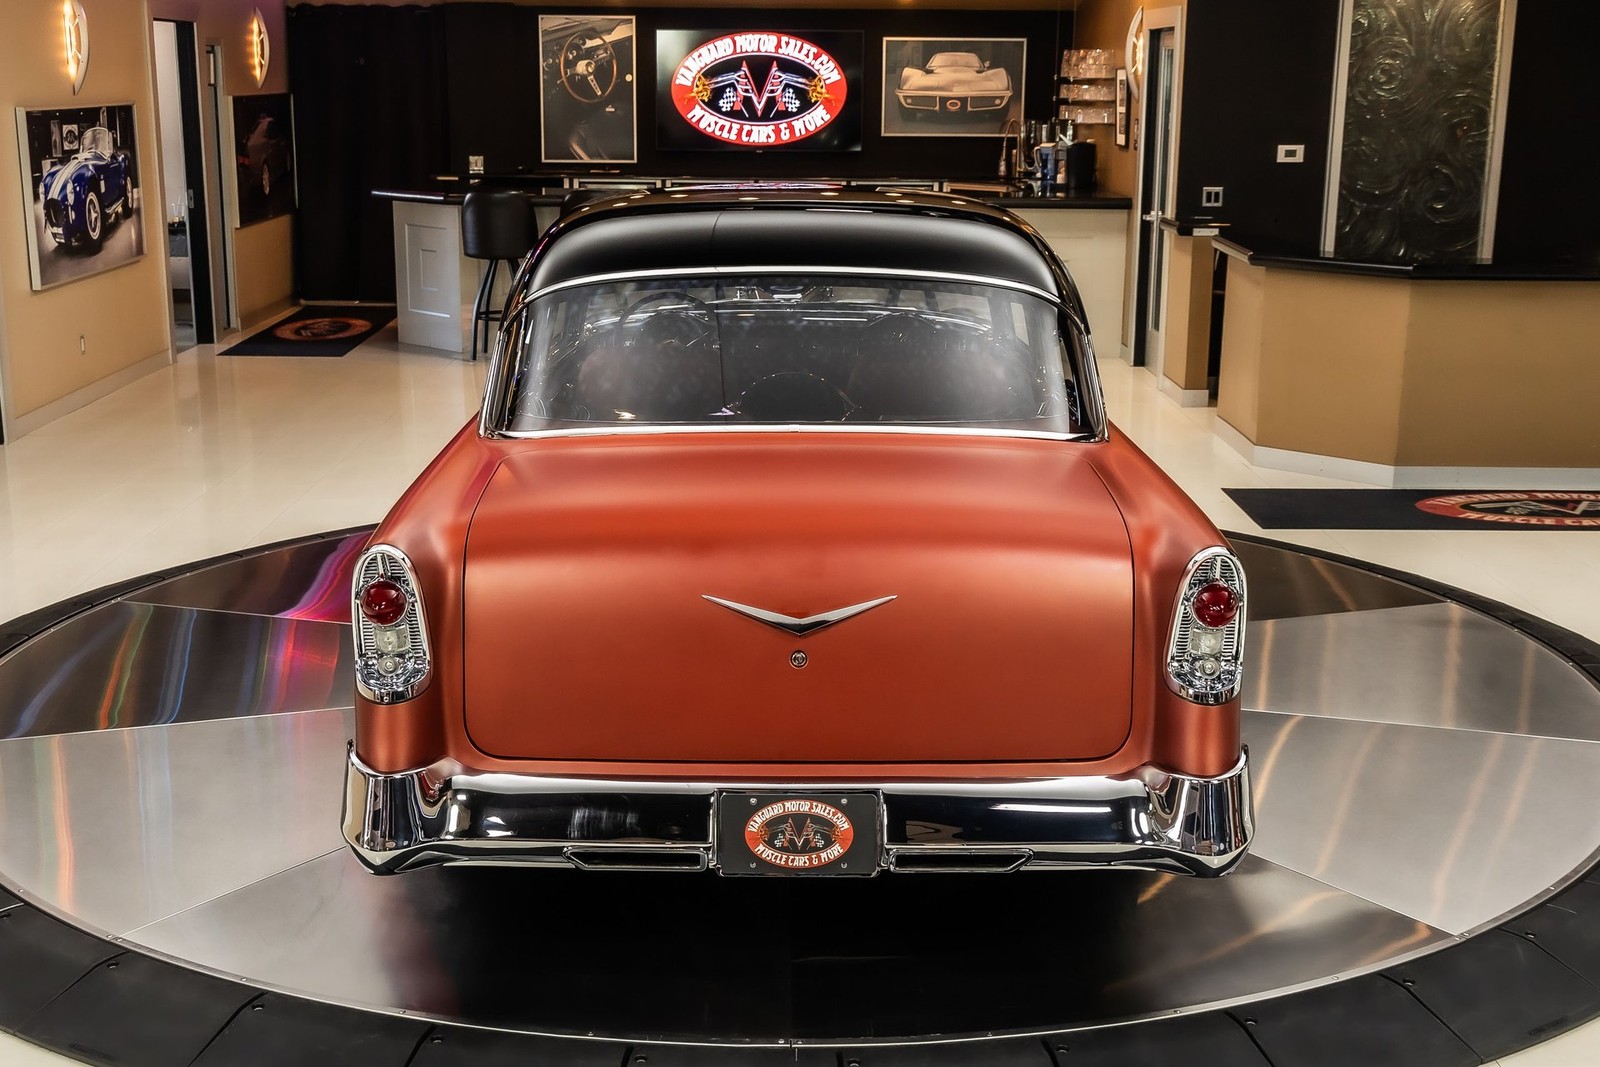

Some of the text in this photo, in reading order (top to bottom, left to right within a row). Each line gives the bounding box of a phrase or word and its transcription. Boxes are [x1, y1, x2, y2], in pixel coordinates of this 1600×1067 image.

[675, 33, 841, 87] VANGUARD MOTOR SALES.COM
[686, 103, 832, 143] MUSCLE CARS & MORE
[748, 800, 850, 833] VANGUARD MOTOR SALES.COM
[754, 843, 844, 867] MUSCLE CARS & MORE
